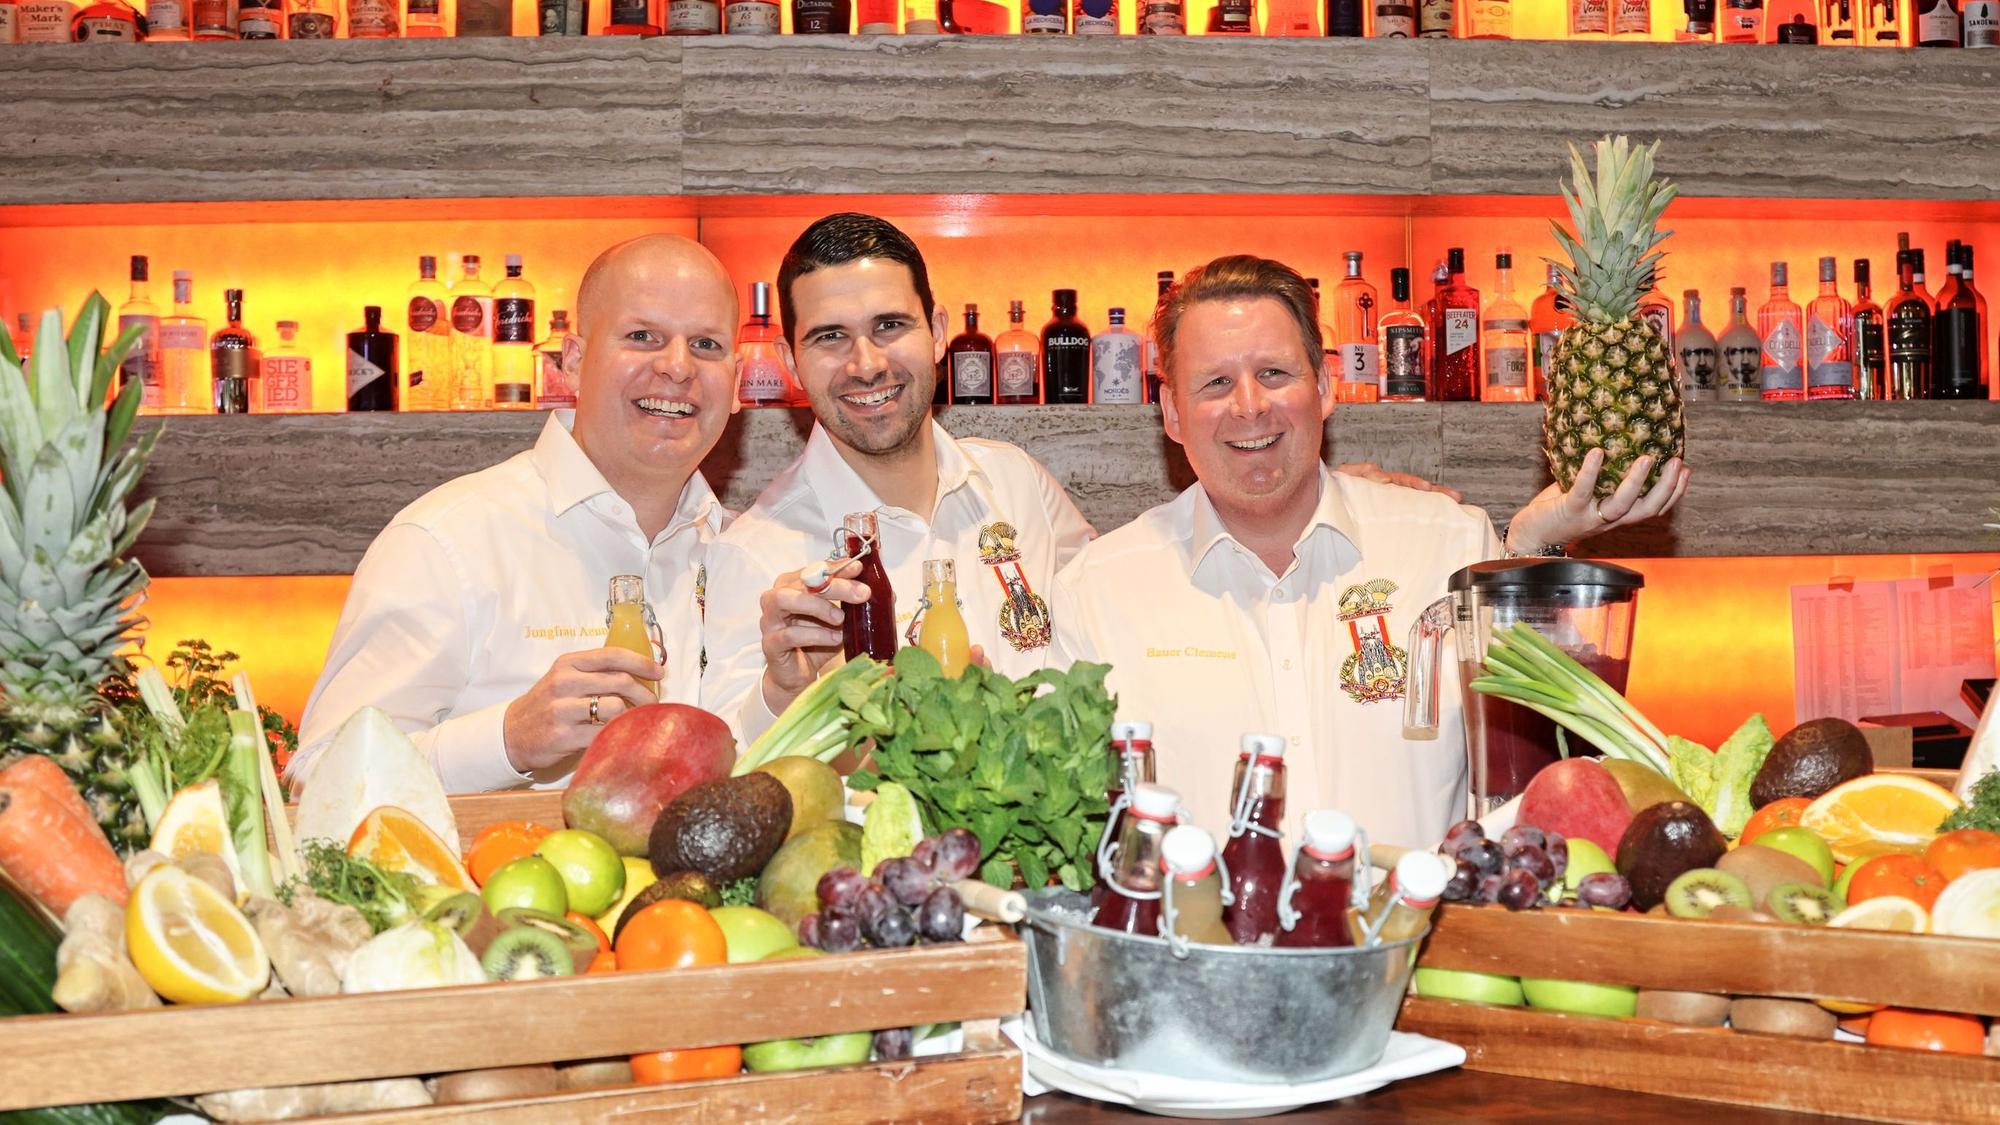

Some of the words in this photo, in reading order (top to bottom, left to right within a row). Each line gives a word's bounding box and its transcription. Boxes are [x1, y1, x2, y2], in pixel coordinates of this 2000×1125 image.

[20, 5, 64, 14] Maker's
[31, 14, 63, 23] Mark
[810, 20, 821, 29] 12
[1454, 319, 1469, 329] 24
[1048, 336, 1089, 347] BULLDOG
[267, 359, 298, 376] SIE
[1354, 353, 1365, 371] 3
[266, 375, 298, 388] GFR
[267, 387, 299, 402] IED
[525, 624, 576, 640] Jungfrau
